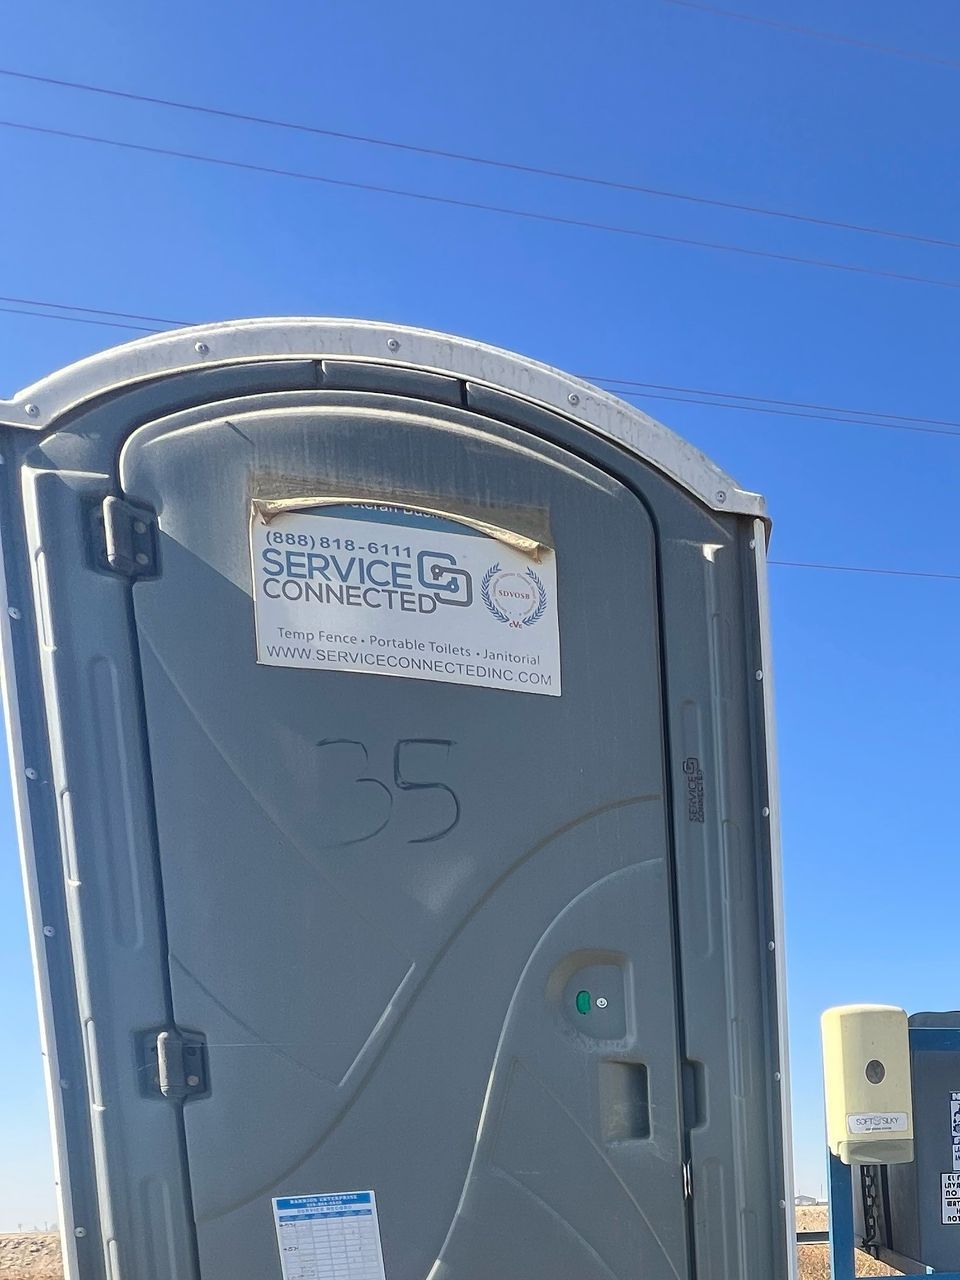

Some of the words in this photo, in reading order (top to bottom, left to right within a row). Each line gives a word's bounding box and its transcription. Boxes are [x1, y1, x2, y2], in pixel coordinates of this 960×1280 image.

[262, 547, 413, 590] SERVICE
[262, 577, 438, 615] CONNECTED
[266, 644, 553, 686] WWW.SERVICECONNECTEDINC.COM
[277, 627, 315, 643] Temp
[318, 630, 358, 645] Fence
[369, 634, 426, 651] Portable
[428, 641, 472, 657] Toilets
[482, 649, 541, 666] Janitorial
[315, 738, 460, 849] 35
[688, 776, 698, 822] SERVICE
[697, 769, 705, 823] CONNECTED
[855, 1117, 873, 1126] SOFT
